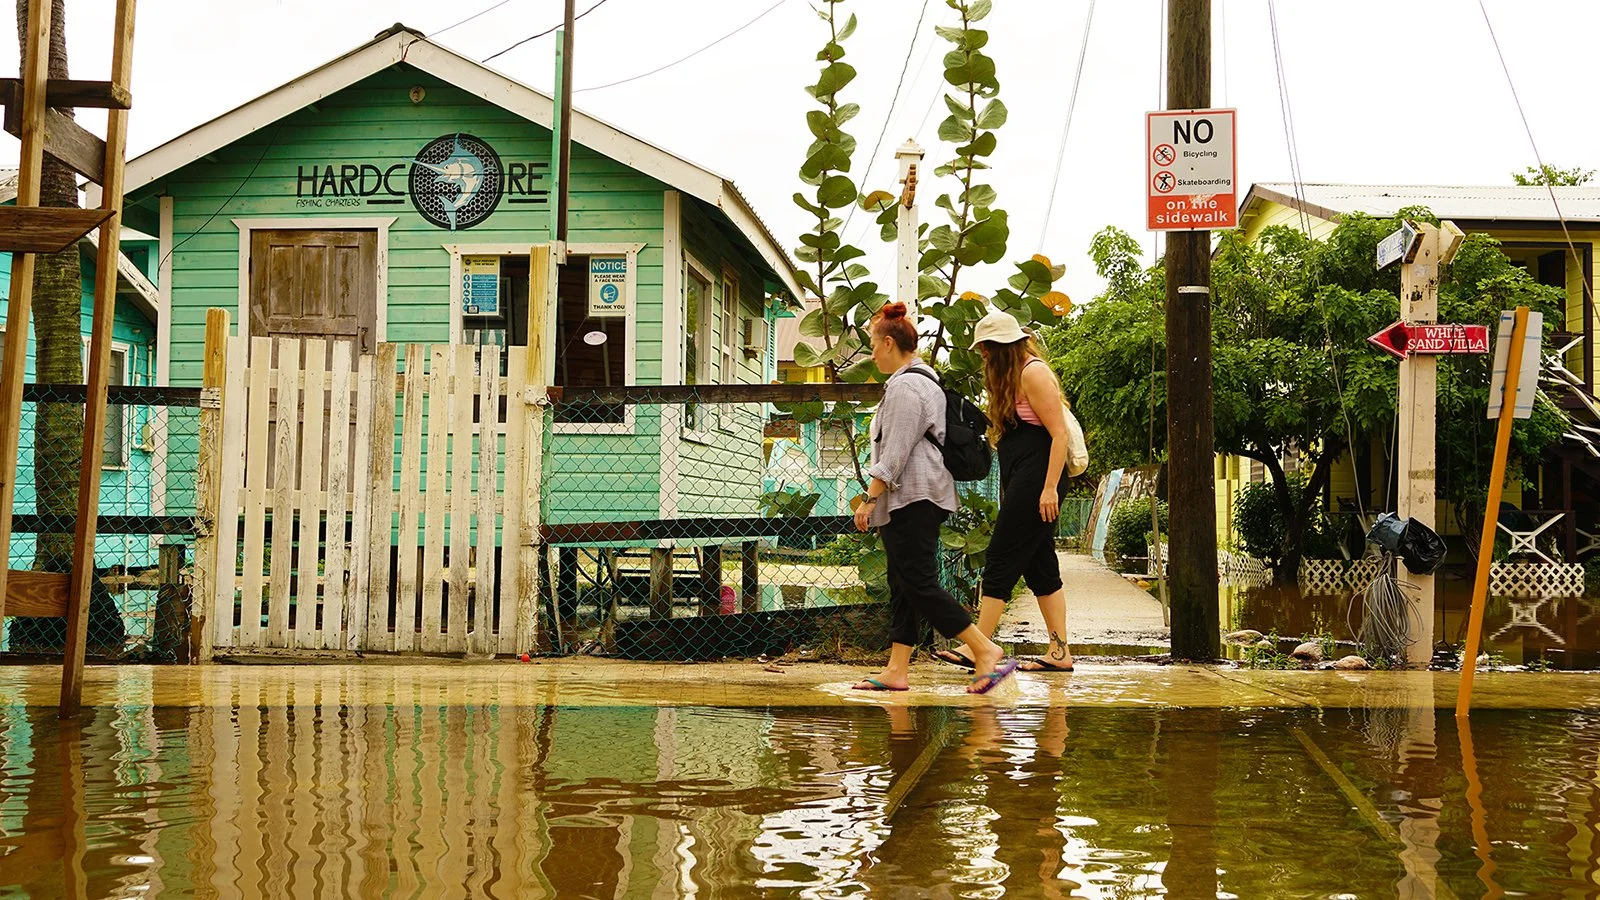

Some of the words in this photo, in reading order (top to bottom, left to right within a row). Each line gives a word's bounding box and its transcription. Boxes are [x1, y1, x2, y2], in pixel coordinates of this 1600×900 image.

[1173, 119, 1214, 145] NO
[1183, 150, 1218, 158] Bicycling
[1177, 178, 1231, 186] Skateboarding
[296, 198, 322, 207] FISHING
[325, 198, 361, 207] CHARTERS
[1166, 200, 1186, 210] on
[1191, 199, 1218, 210] the
[1156, 210, 1229, 223] sidewalk
[592, 261, 627, 271] NOTICE
[1424, 327, 1467, 339] WHITE
[1407, 338, 1445, 350] SAND
[1448, 338, 1485, 350] VILLA
